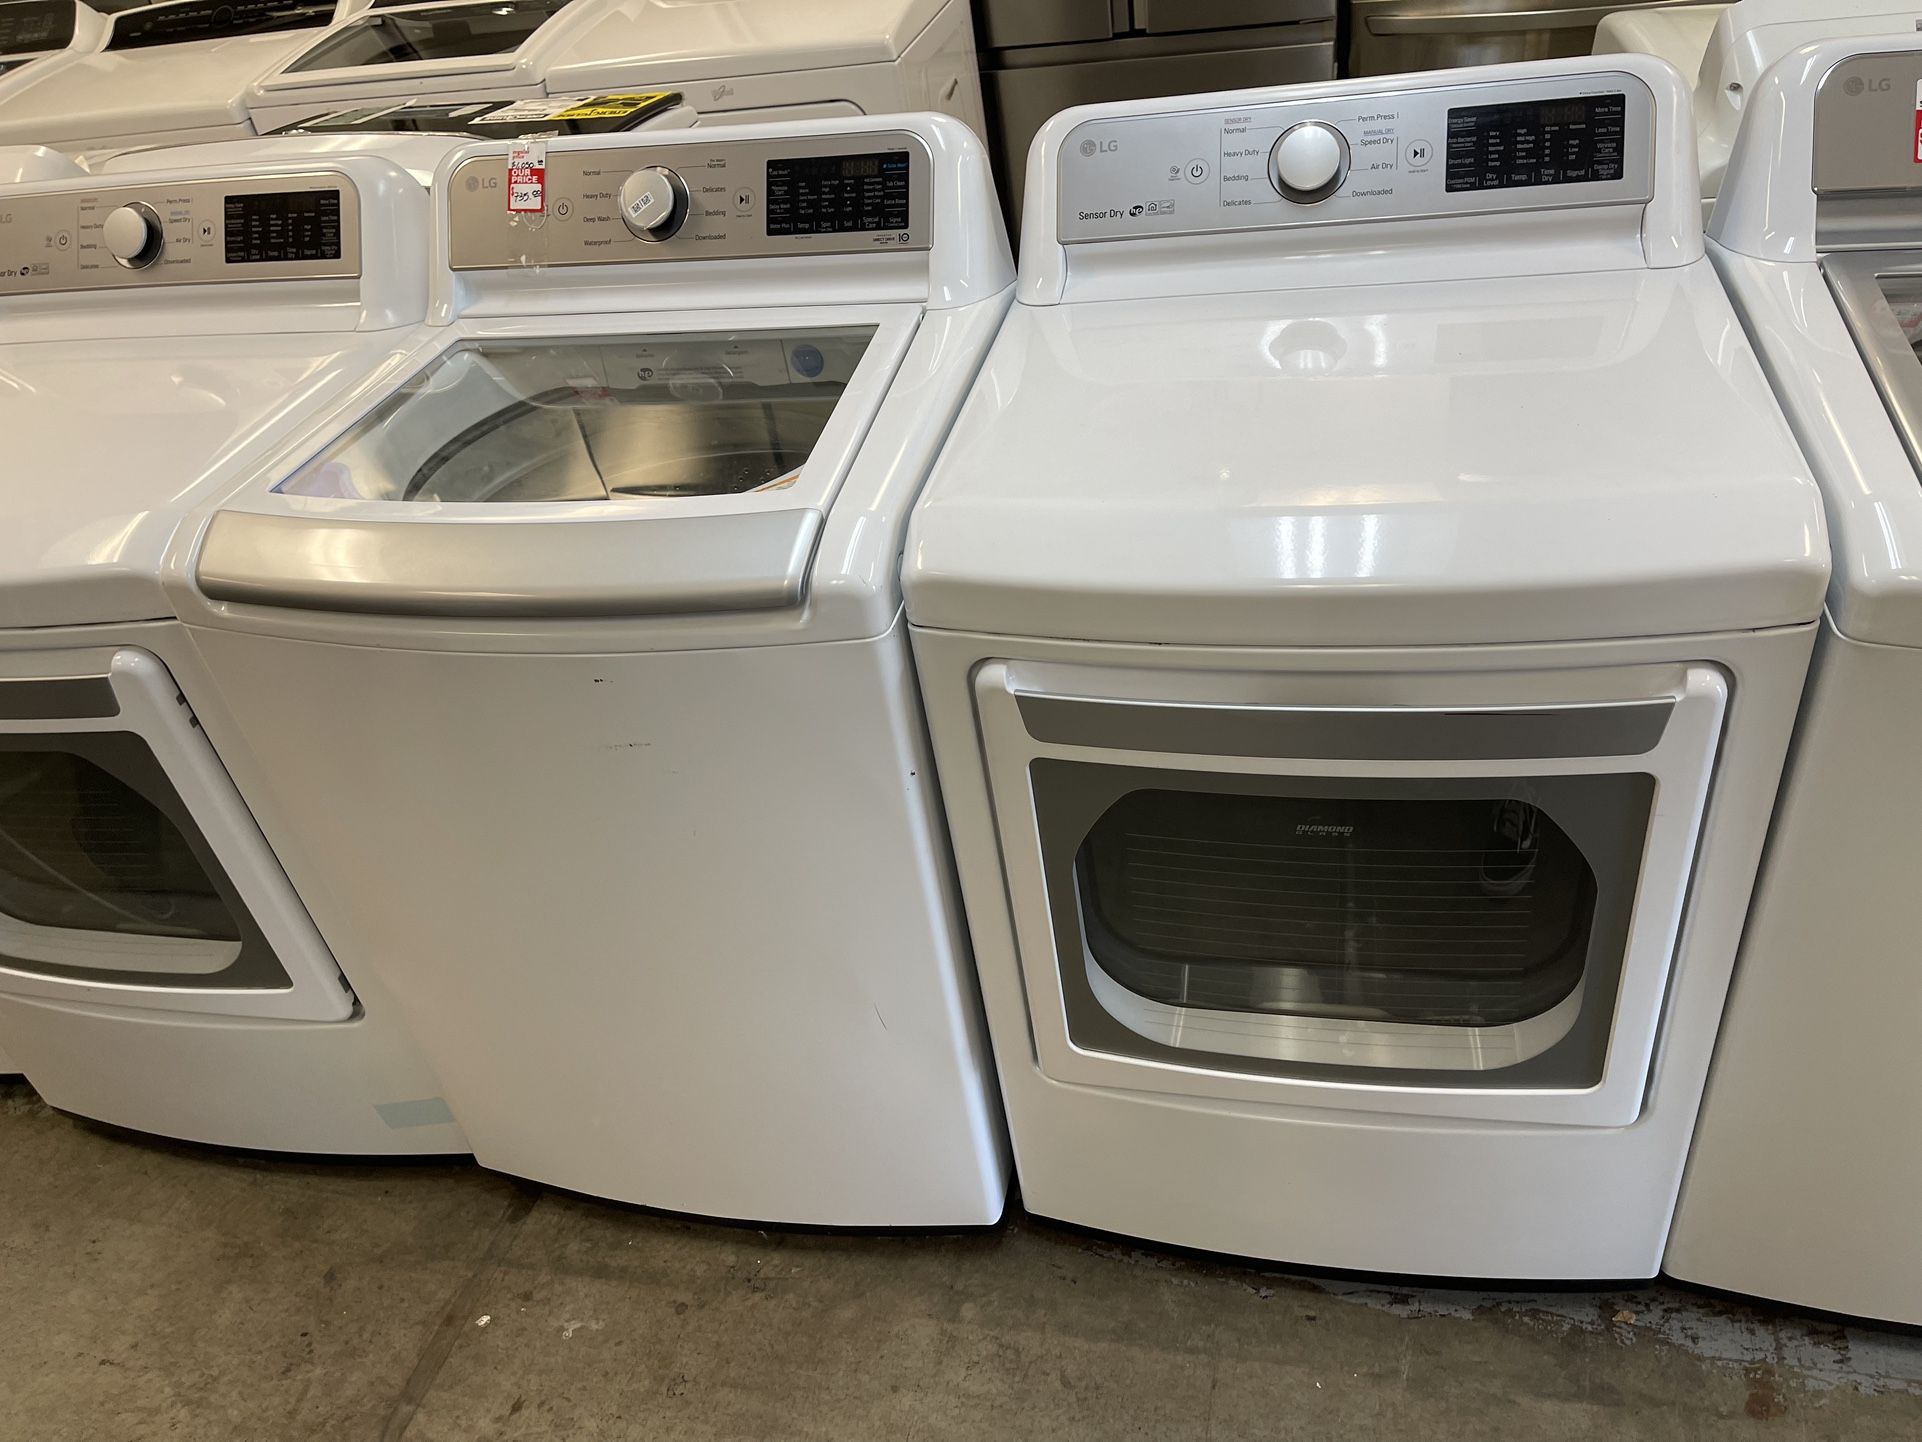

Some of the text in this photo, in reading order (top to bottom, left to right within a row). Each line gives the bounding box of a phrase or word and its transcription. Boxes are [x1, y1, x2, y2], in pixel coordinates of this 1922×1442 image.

[1868, 78, 1891, 92] LG
[1223, 127, 1247, 135] Normal
[1099, 140, 1118, 153] LG
[1360, 137, 1394, 147] Speed Dry
[1223, 149, 1260, 158] Heavy Duty
[1382, 162, 1393, 171] Dry
[512, 175, 538, 184] PRICE
[1223, 174, 1249, 182] Bedding
[481, 178, 497, 188] LG
[599, 192, 611, 200] Duty
[1351, 188, 1393, 197] Downloaded
[1222, 199, 1252, 207] Delicates
[1078, 209, 1107, 221] Sensor
[1109, 209, 1125, 220] Dry
[1296, 824, 1354, 833] DIAMOND
